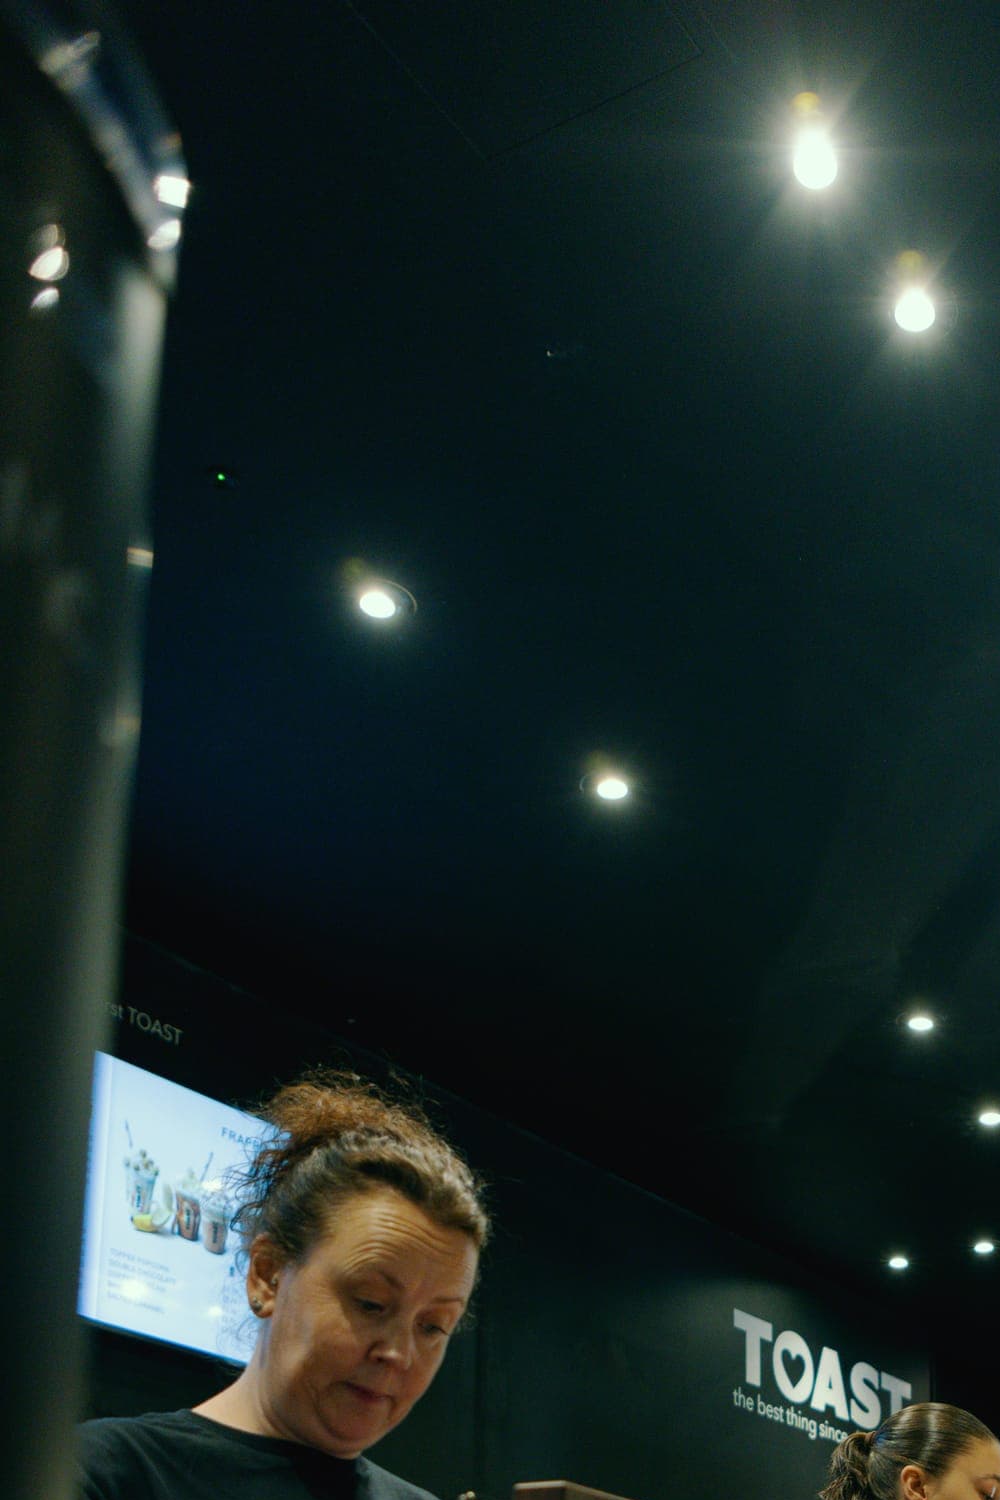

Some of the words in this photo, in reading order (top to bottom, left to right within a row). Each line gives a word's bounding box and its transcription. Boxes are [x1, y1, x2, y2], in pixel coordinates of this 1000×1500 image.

[128, 1006, 184, 1047] TOAST
[733, 1308, 912, 1430] TOAST
[733, 1387, 754, 1411] the
[757, 1394, 784, 1423] best
[786, 1406, 817, 1440] thing
[819, 1420, 848, 1442] since
